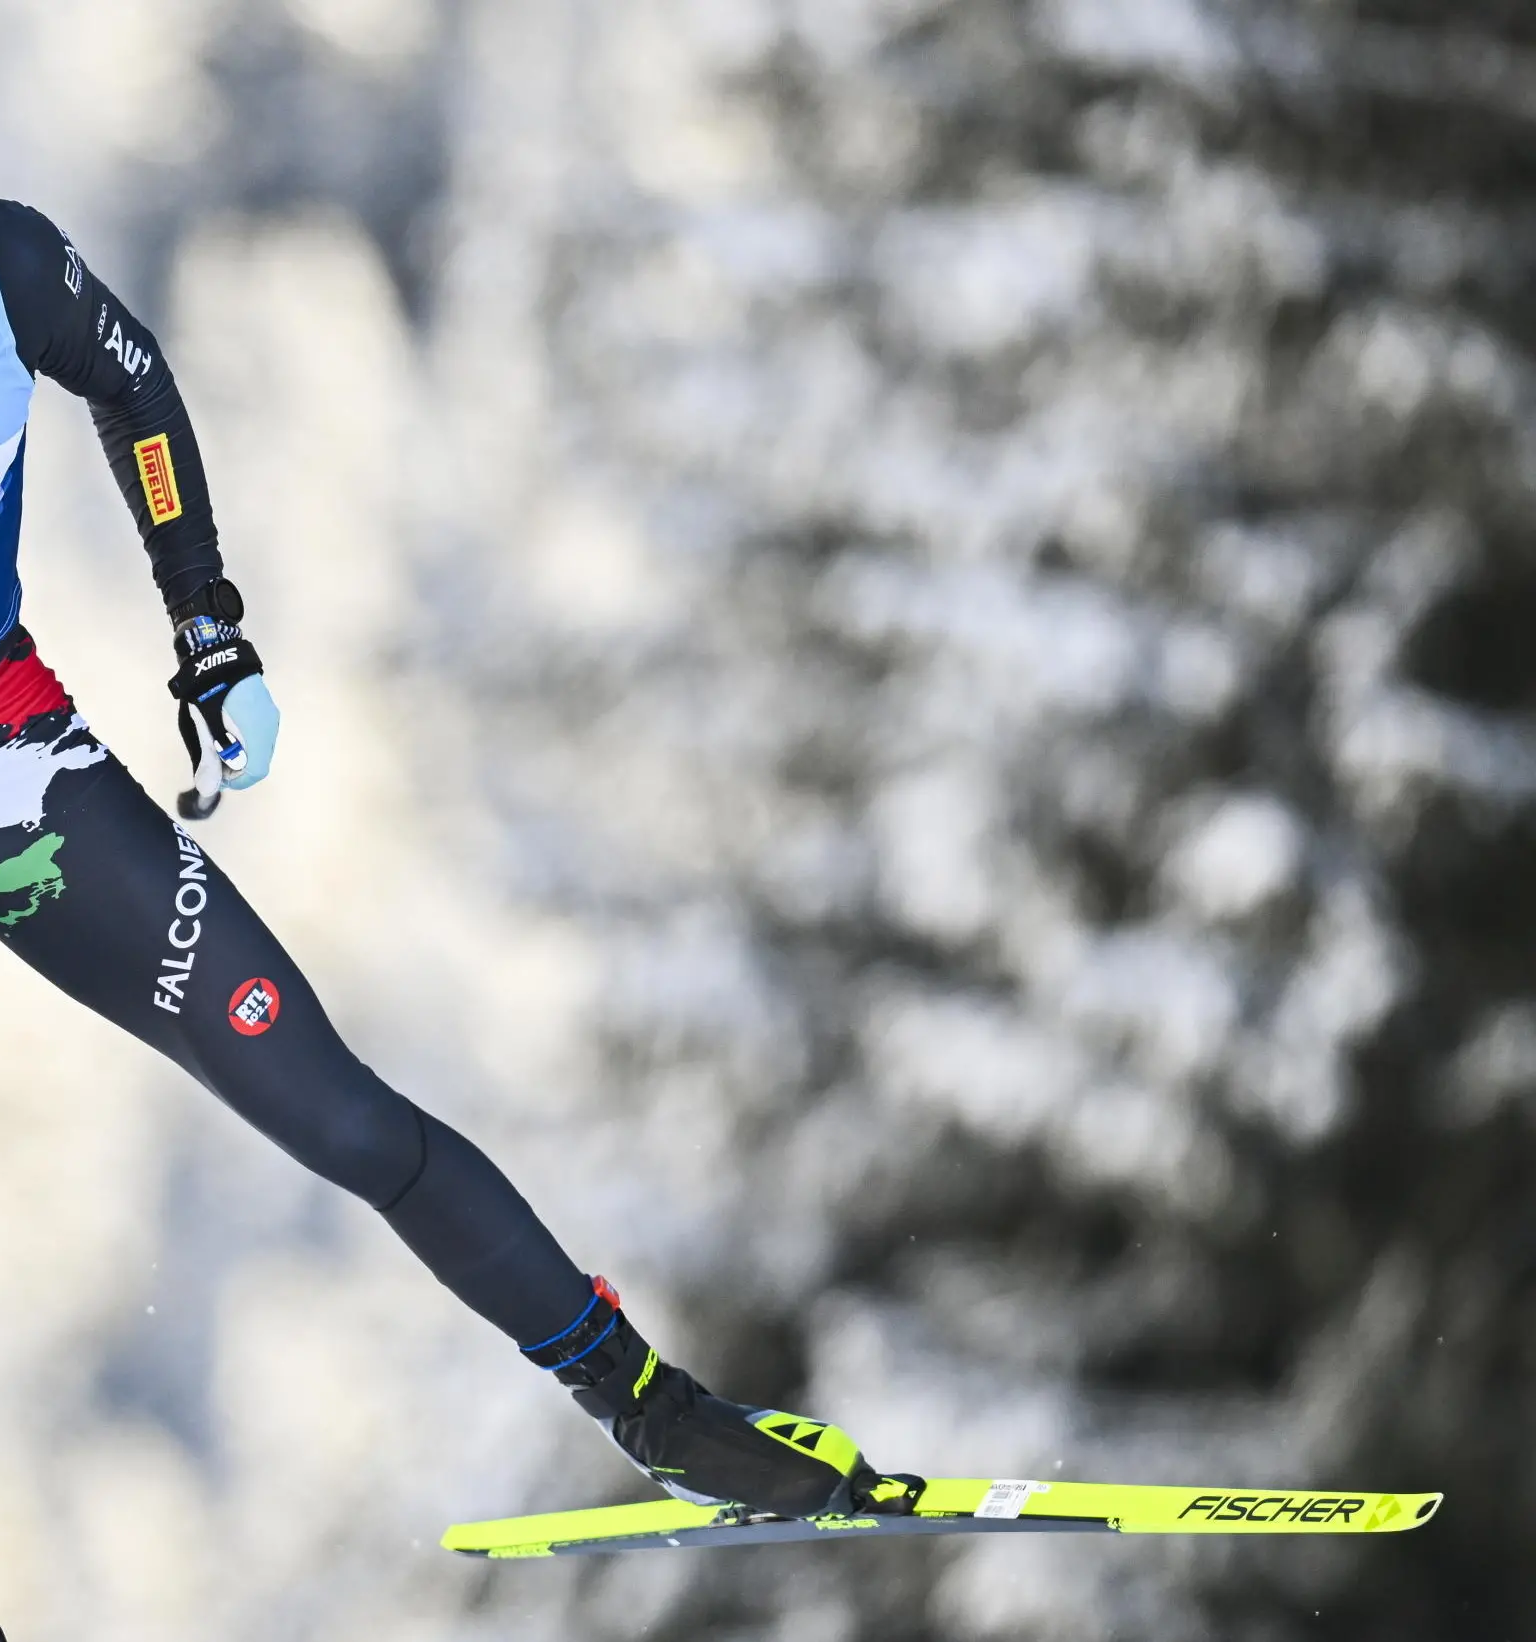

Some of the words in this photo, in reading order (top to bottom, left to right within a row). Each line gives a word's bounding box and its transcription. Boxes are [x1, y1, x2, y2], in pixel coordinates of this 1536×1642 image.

[140, 442, 175, 513] PIRELLI
[235, 988, 267, 1021] RTL
[1176, 1495, 1365, 1523] FISCHER
